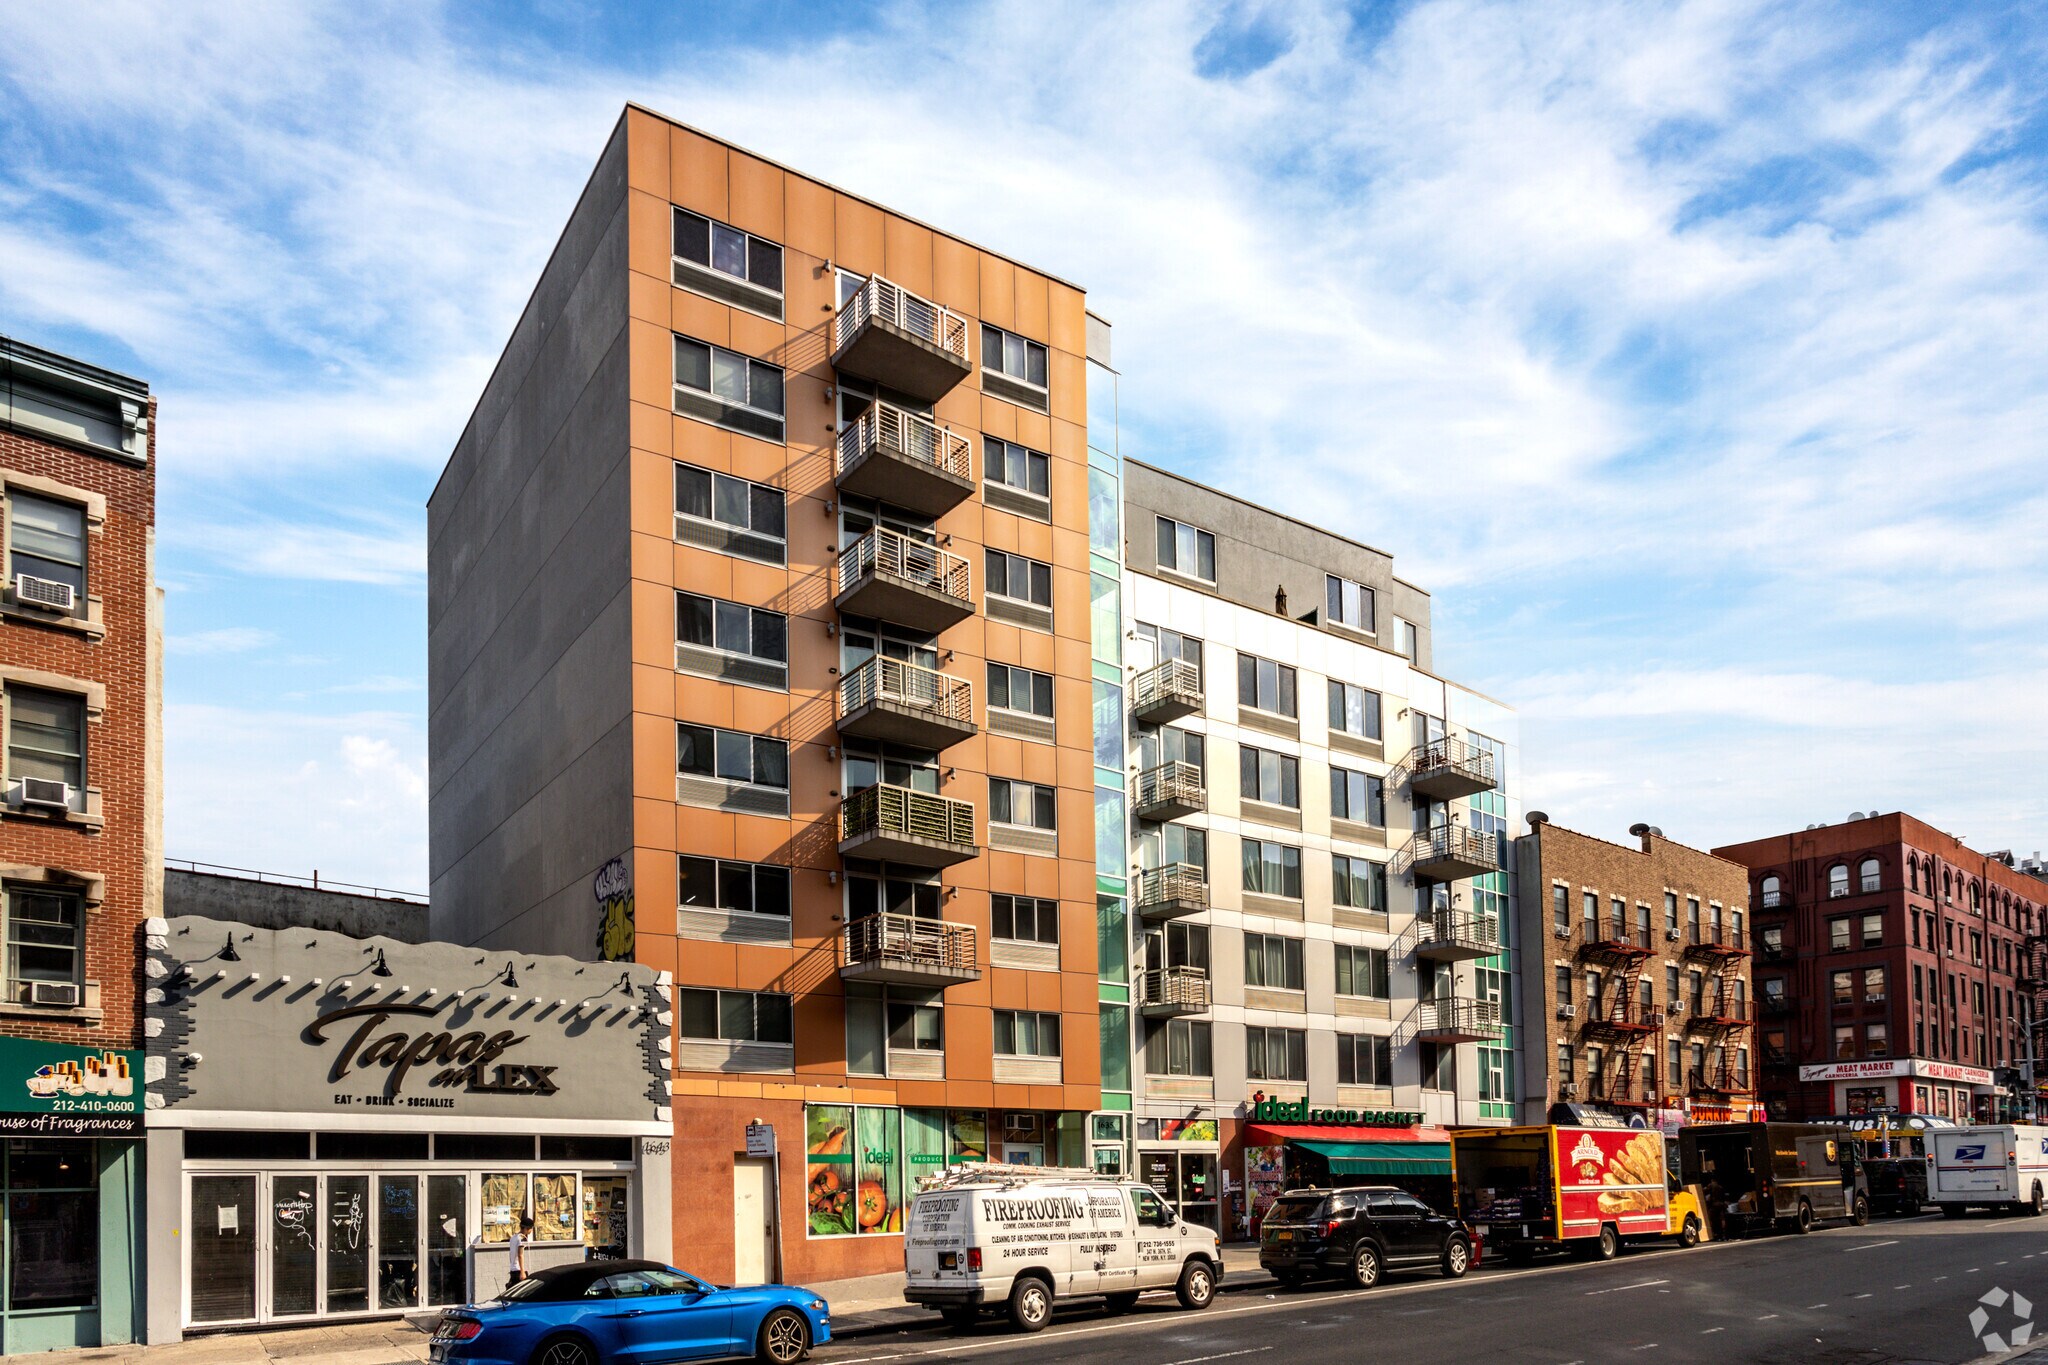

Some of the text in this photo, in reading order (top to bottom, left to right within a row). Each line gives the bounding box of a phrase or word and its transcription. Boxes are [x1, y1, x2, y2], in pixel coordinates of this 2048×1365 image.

[310, 1004, 530, 1094] Tapas
[1837, 1062, 1894, 1073] MEAT MARKET
[1928, 1063, 1942, 1077] MEAT
[1943, 1066, 1963, 1080] MARKET
[1965, 1068, 1989, 1079] CARNICERIA
[437, 1062, 560, 1091] on LEX
[53, 1100, 135, 1111] 212-410-0600
[334, 1094, 454, 1108] EAT DRINK SOCIALIZE
[1253, 1090, 1426, 1125] ideal FOOD BASKET
[31, 1114, 48, 1131] of
[50, 1115, 135, 1133] Fragrances
[1098, 1121, 1113, 1129] 1635
[864, 1146, 893, 1164] ideal
[1577, 1148, 1598, 1156] ARNOLD
[918, 1199, 959, 1213] FIREPROOFING
[982, 1197, 1084, 1222] FIREPROOFING
[1089, 1208, 1121, 1218] OF AMERICA
[923, 1224, 930, 1232] OF
[1036, 1221, 1054, 1229] EXHAUST
[911, 1238, 959, 1247] Fireproofingcorp.com
[991, 1235, 1010, 1243] CLEANING
[1003, 1247, 1048, 1258] 24 HOUR SERVICE
[1080, 1245, 1094, 1253] FULLY
